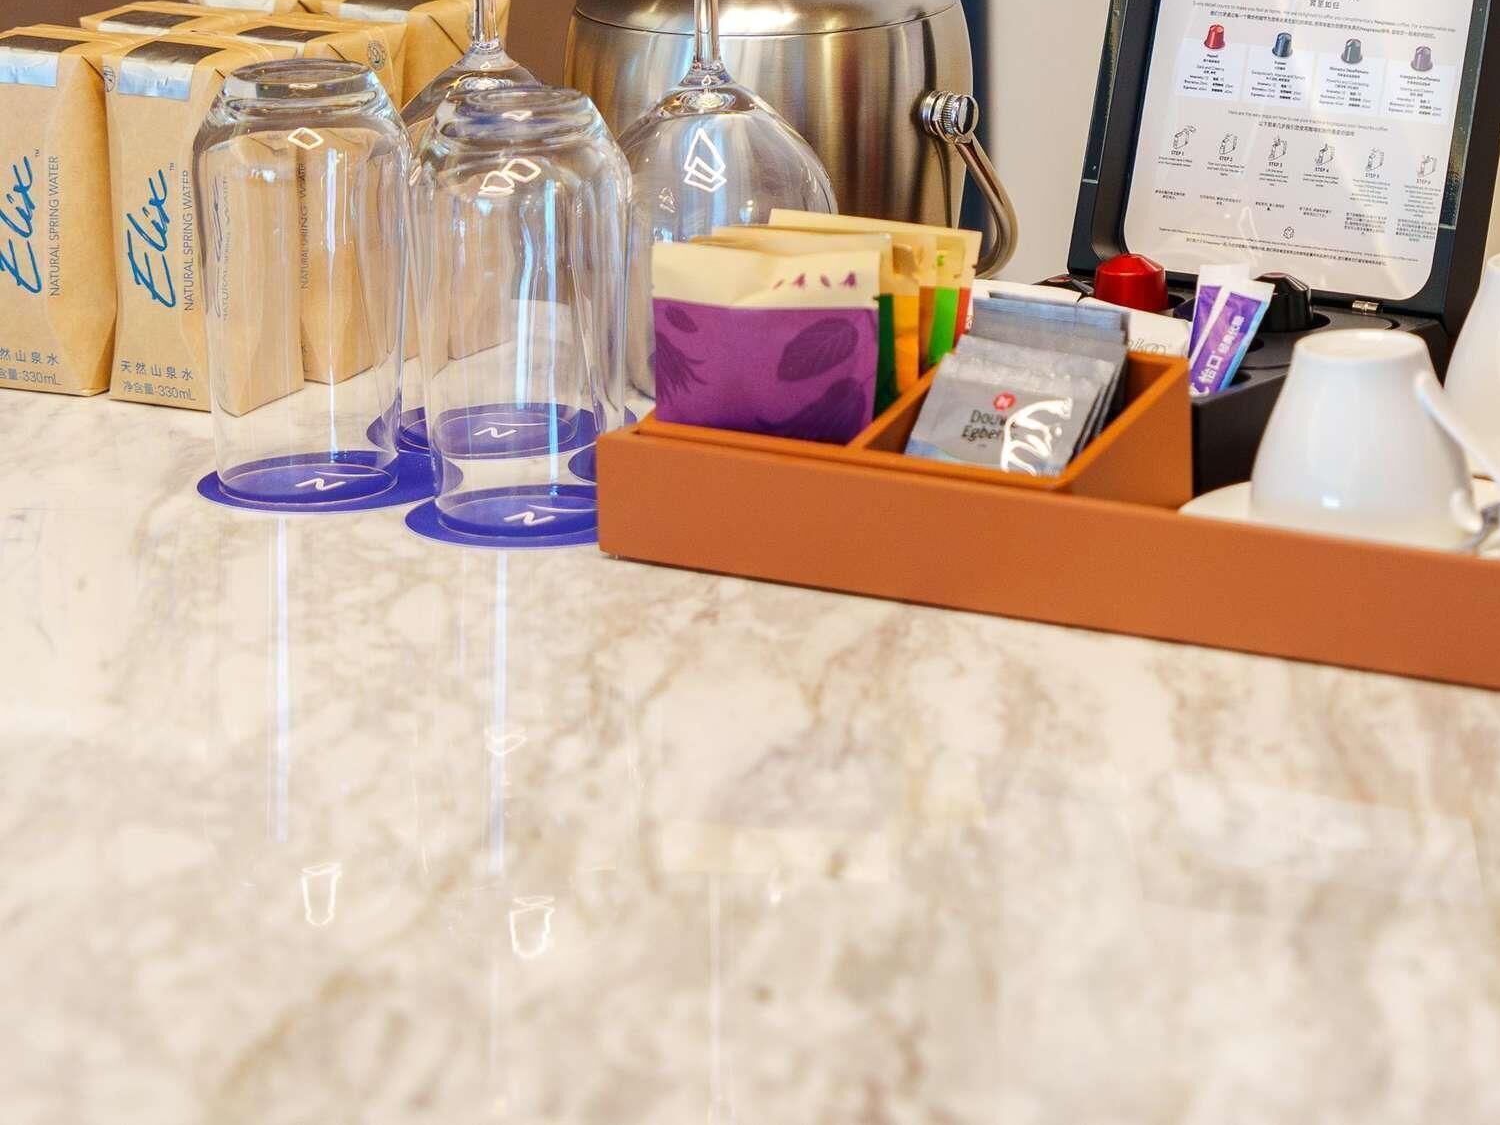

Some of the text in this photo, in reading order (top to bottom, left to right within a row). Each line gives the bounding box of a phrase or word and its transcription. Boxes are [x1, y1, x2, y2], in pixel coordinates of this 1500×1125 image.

[0, 155, 42, 295] Elix
[47, 155, 60, 297] NATURAL SPRING WATER
[127, 169, 176, 308] Elix
[182, 213, 193, 256] SPRING
[183, 257, 194, 311] NATURAL
[121, 360, 194, 381] 天然山泉水
